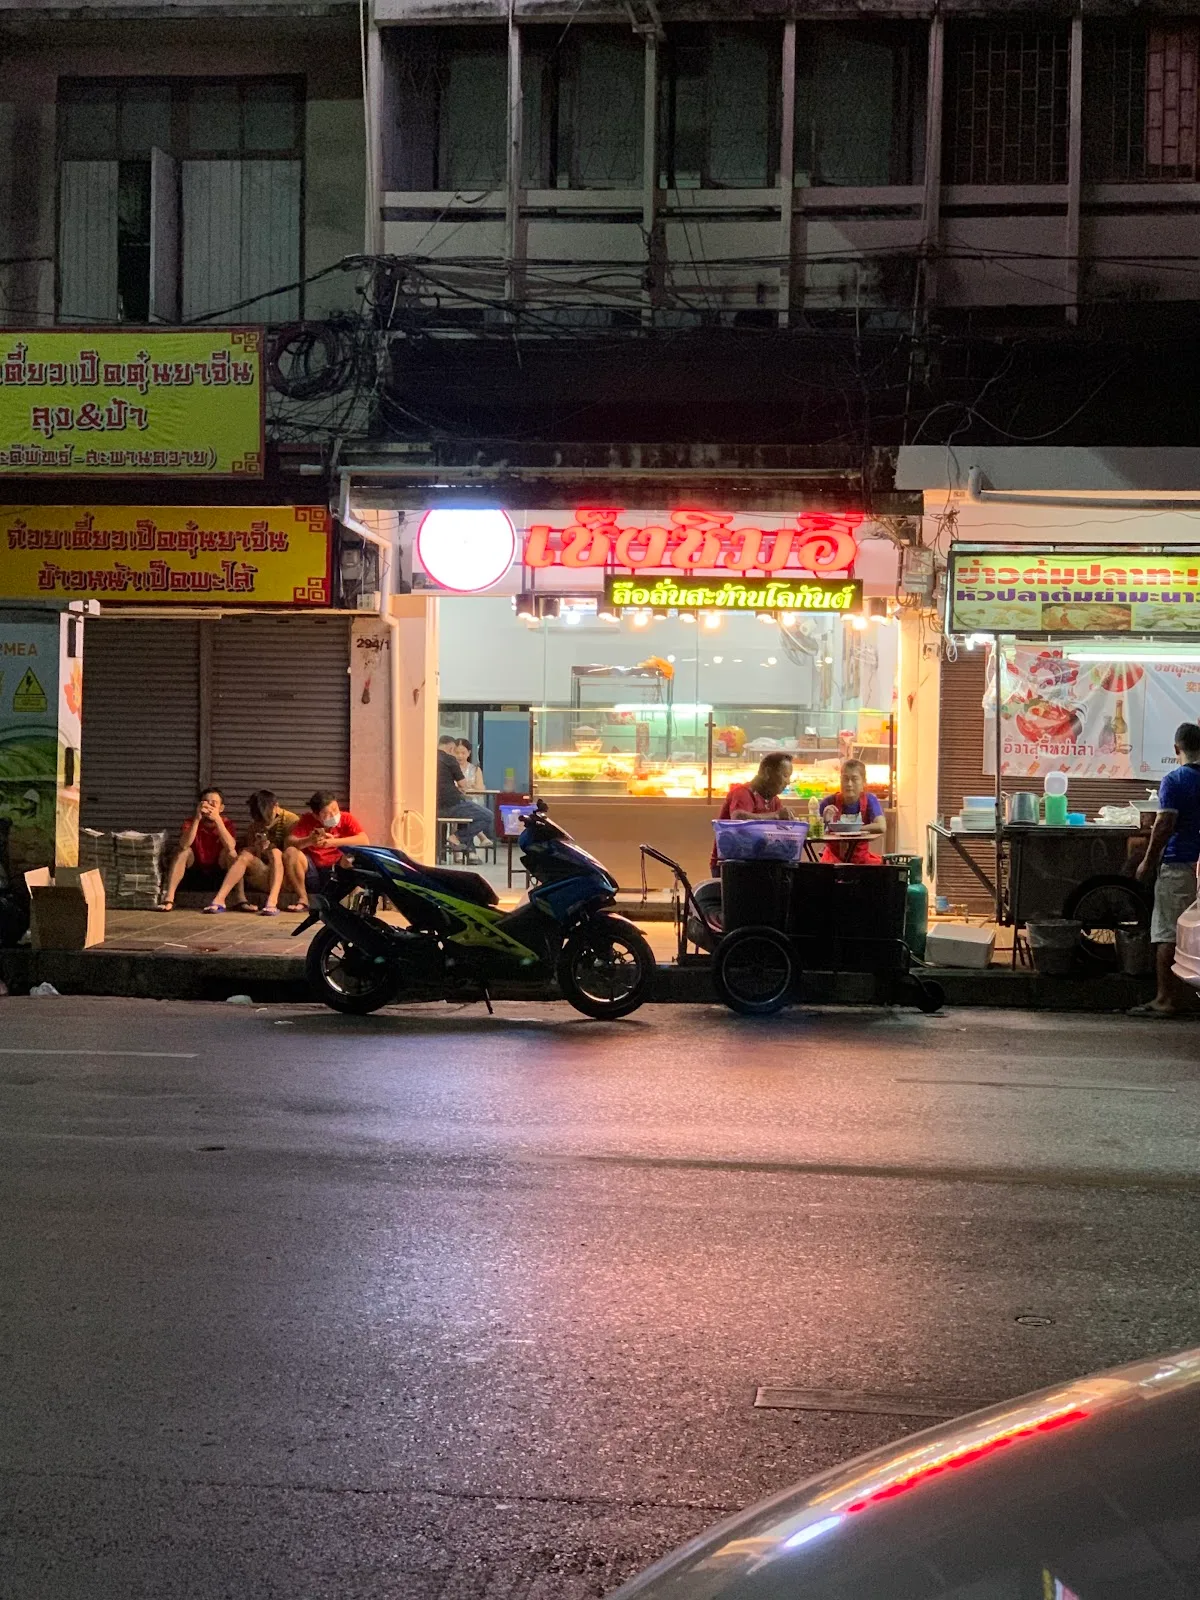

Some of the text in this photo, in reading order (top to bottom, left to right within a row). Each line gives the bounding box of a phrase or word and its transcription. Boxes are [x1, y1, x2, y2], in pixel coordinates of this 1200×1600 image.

[31, 397, 149, 438] ลุง&ป้า
[7, 512, 289, 559] ก๋วยเตี๋ยวเป็ดตุ๋นยาจีน
[38, 560, 258, 592] ข้าวหน้าเป็ดพะโล้
[613, 578, 855, 609] ลือลั่นสะท้านโลกันต์
